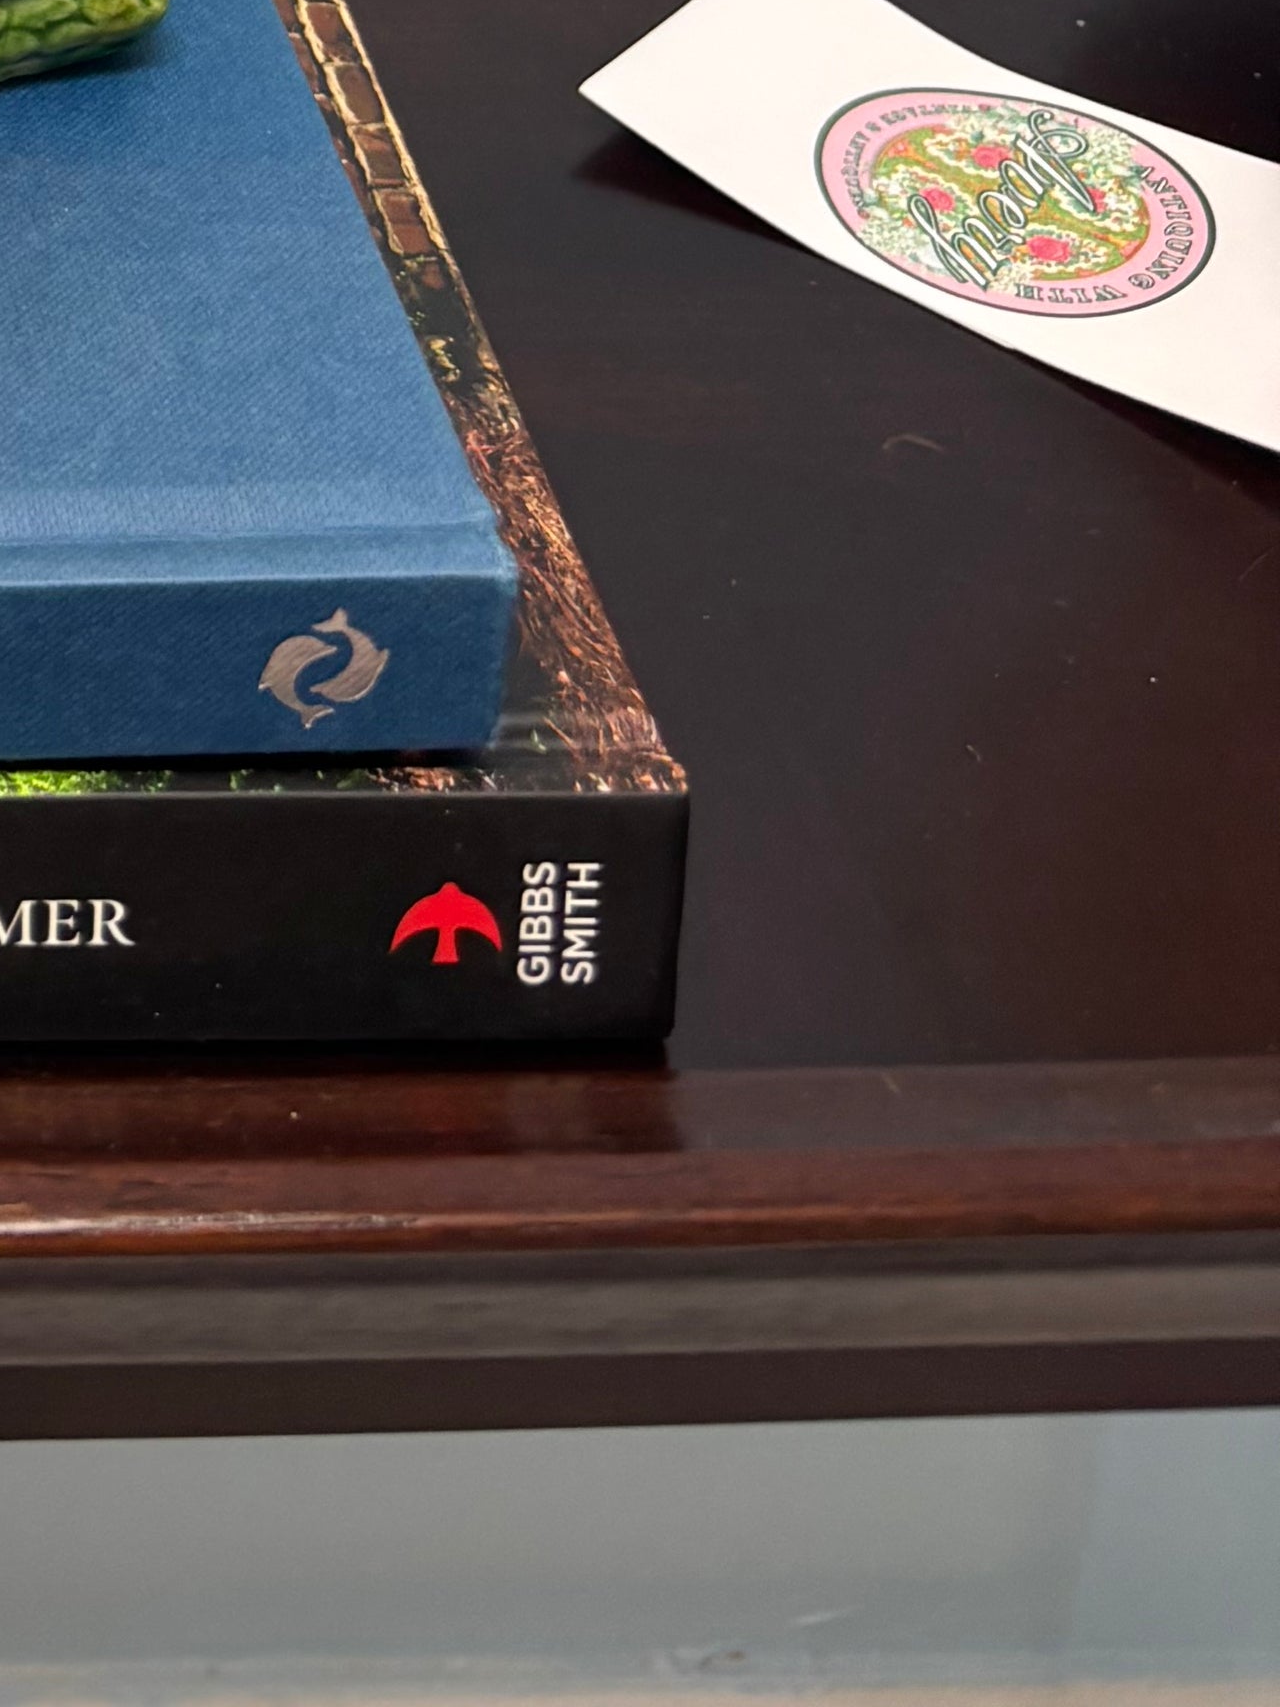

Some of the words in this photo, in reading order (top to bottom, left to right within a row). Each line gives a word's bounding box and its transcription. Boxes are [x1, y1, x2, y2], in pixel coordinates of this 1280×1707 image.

[908, 110, 1097, 290] Avery
[1015, 283, 1128, 304] WITH
[517, 861, 558, 985] GIBBS
[560, 862, 602, 984] SMITH
